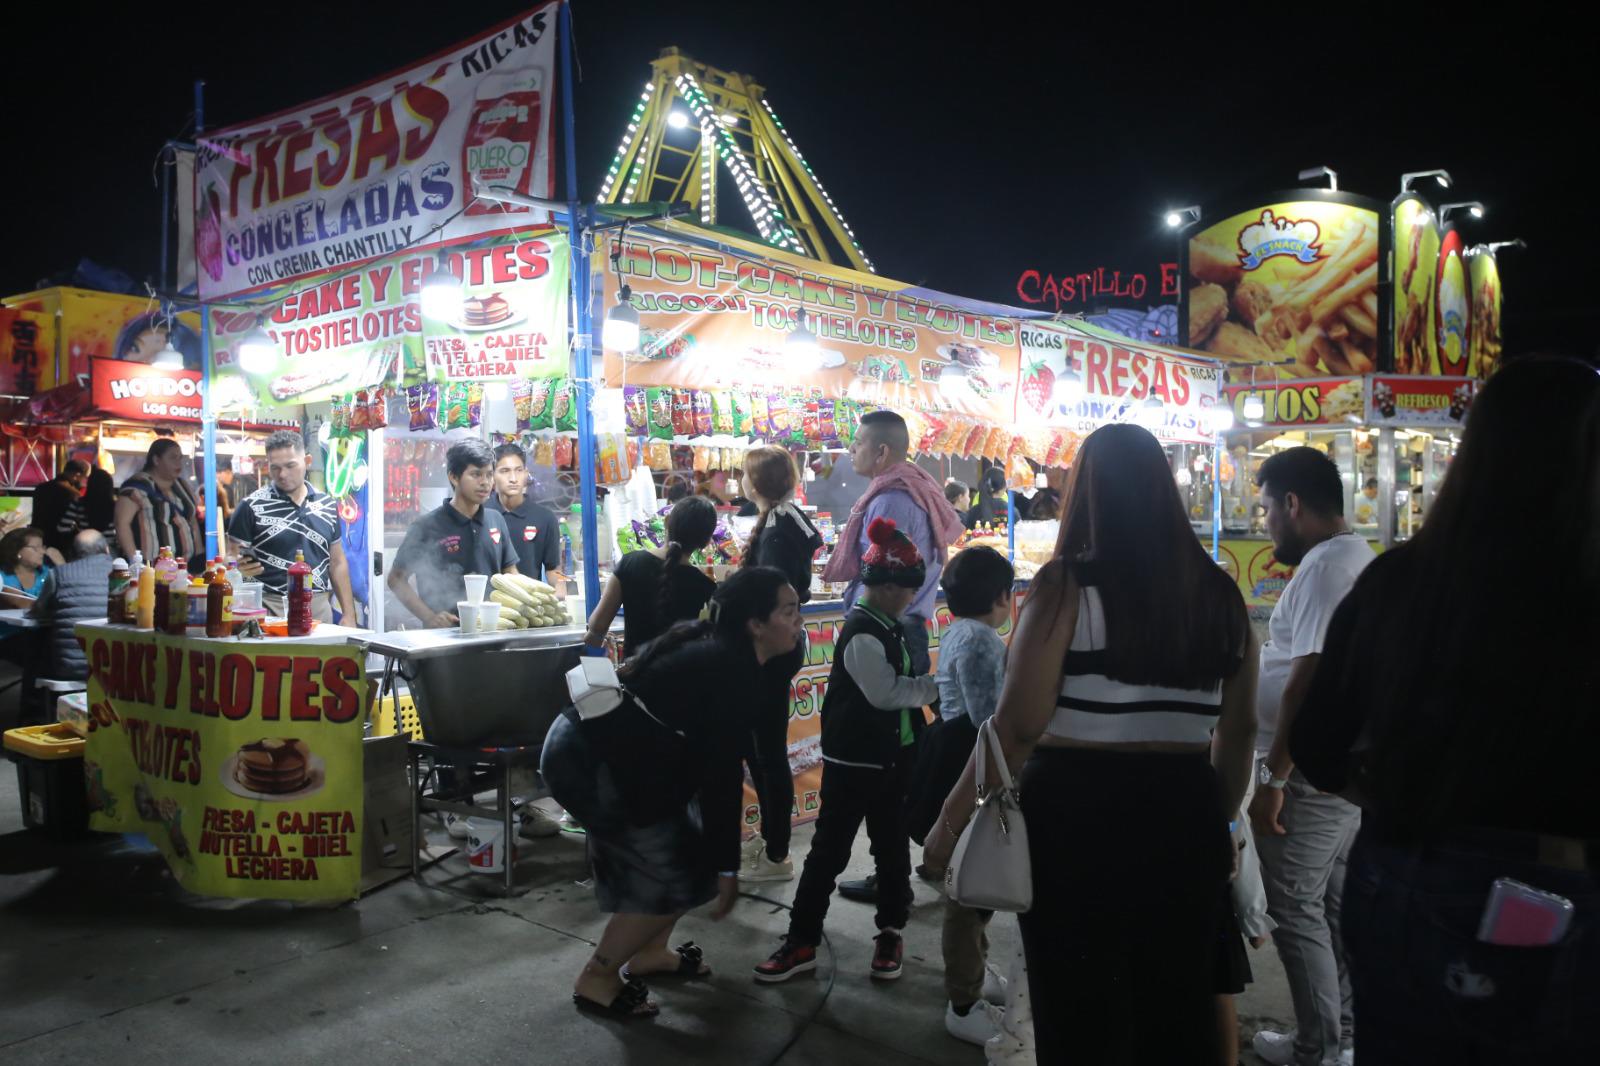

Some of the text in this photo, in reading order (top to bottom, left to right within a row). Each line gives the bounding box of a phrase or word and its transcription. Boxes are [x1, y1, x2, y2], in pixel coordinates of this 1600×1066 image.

[461, 11, 548, 78] RICAS
[469, 144, 527, 170] DUERO
[226, 161, 454, 266] CONGELADAS
[247, 225, 413, 286] CON CREMA CHANTILLY
[367, 267, 392, 300] Y
[1017, 268, 1147, 310] CASTILLO
[283, 302, 421, 356] TOSTIELOTES
[862, 286, 888, 317] Y
[896, 296, 1016, 346] ELOTES
[1021, 330, 1062, 349] RICAS
[1065, 339, 1190, 406] FRESAS
[1190, 367, 1217, 381] RICAS
[163, 645, 183, 709] Y
[189, 647, 360, 723] ELOTES
[203, 806, 256, 833] FRESA
[276, 811, 355, 835] CAJETA
[199, 832, 281, 858] NUTELLA
[225, 857, 319, 880] LECHERA
